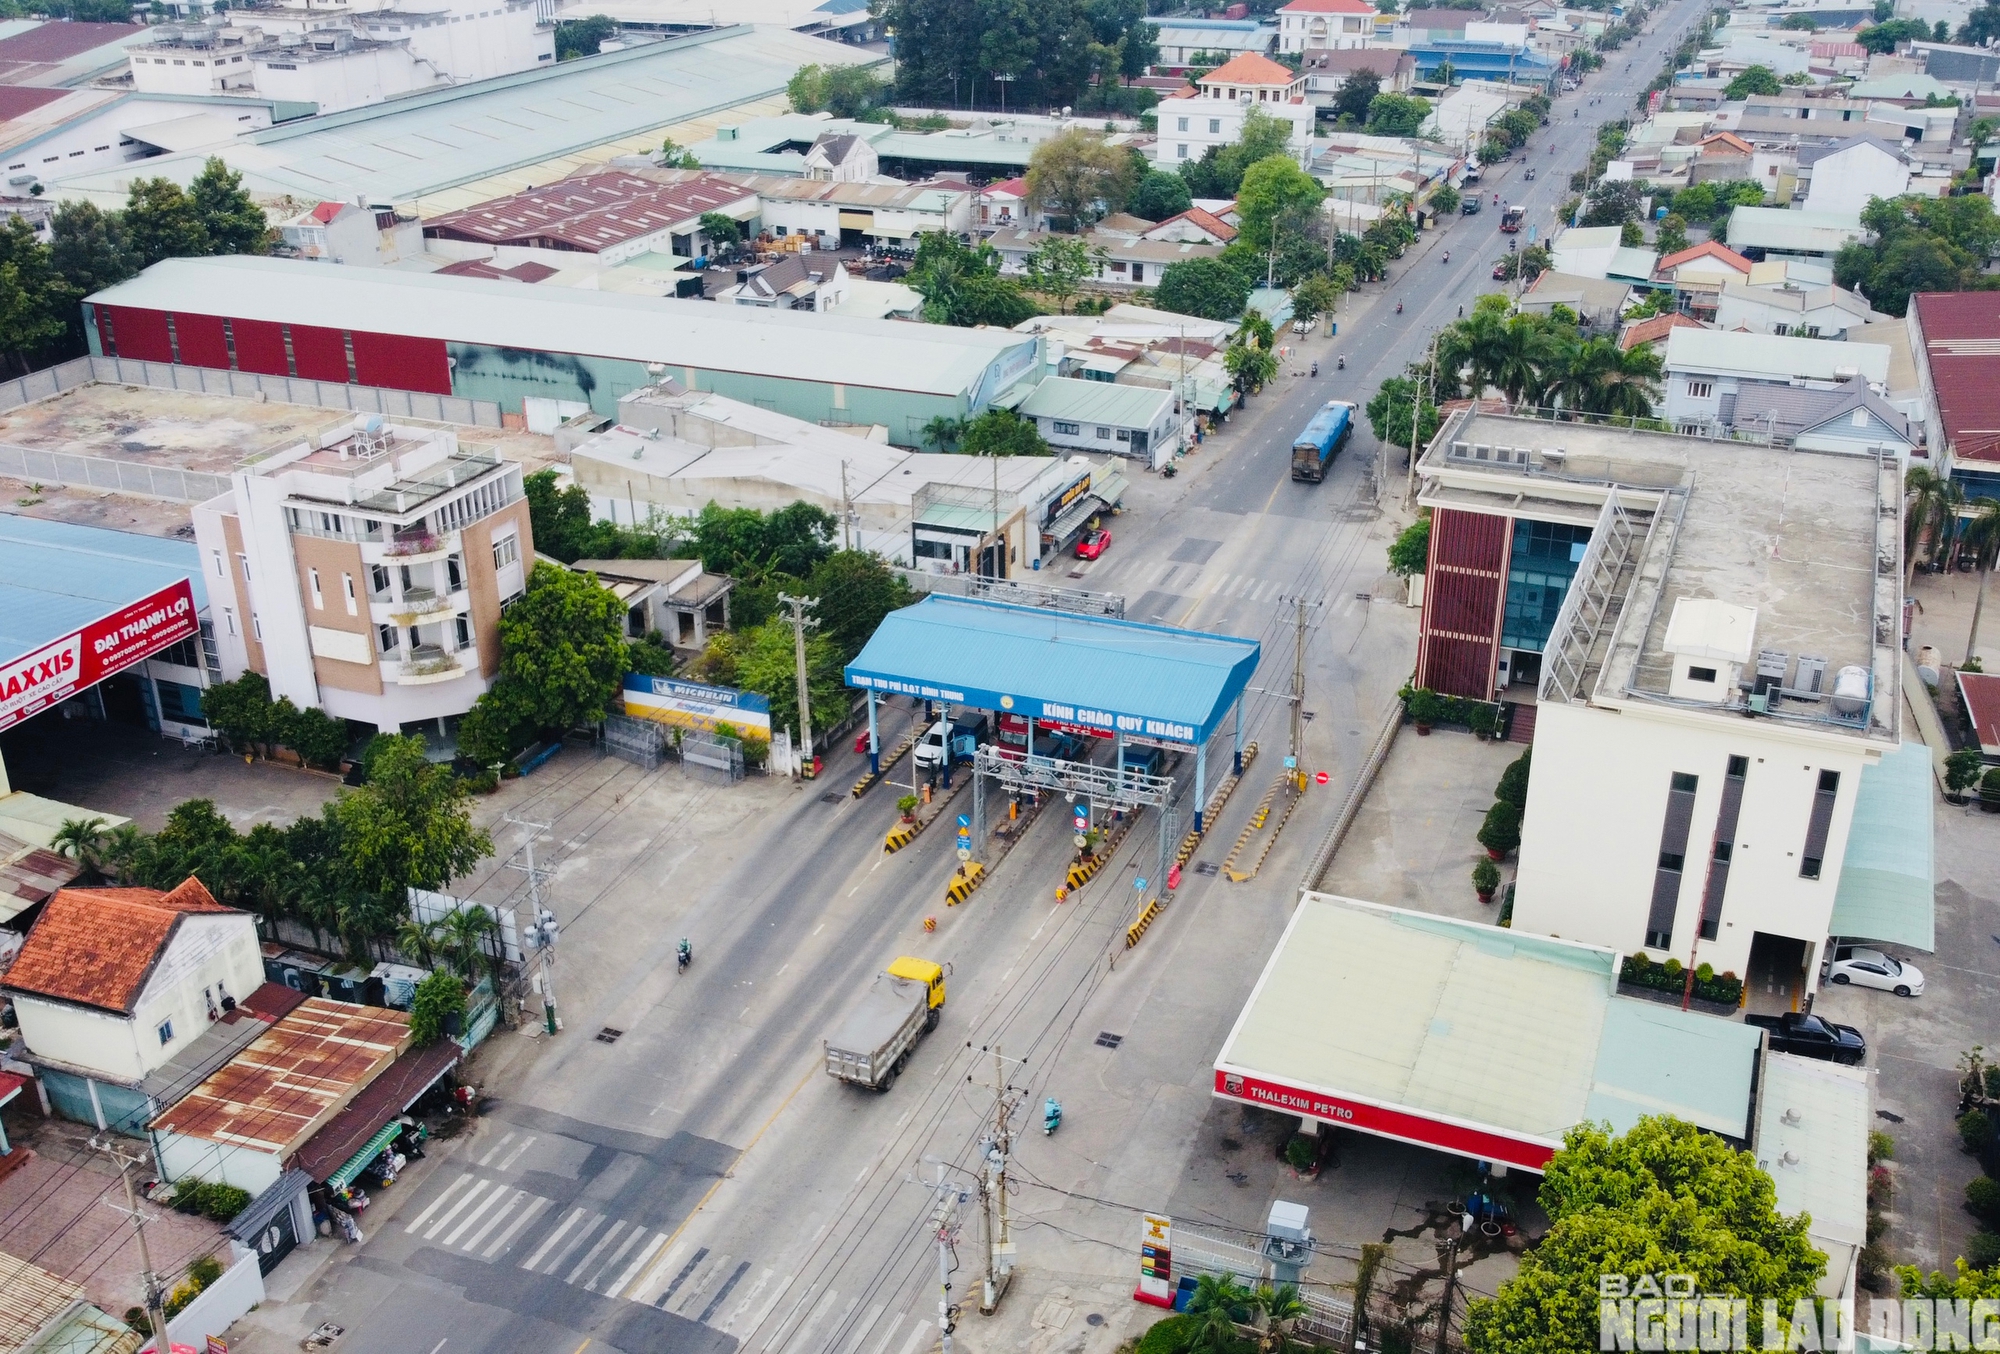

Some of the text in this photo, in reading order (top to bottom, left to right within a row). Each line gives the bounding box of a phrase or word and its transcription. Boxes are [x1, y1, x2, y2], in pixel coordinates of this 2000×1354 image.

[94, 632, 120, 654] ĐẠI
[120, 609, 166, 640] THẠNH
[167, 597, 190, 618] LỢI
[38, 684, 50, 694] CAO
[52, 677, 64, 686] CẤP
[674, 686, 733, 702] MICHELIN
[873, 678, 888, 688] THU
[889, 681, 901, 691] PHÍ
[902, 684, 920, 694] B.O.T
[1043, 702, 1193, 740] KÍNH CHÀO QUÝ KHÁCH
[1060, 726, 1092, 735] ETC
[1251, 1087, 1310, 1110] THALEXIM
[1314, 1102, 1353, 1119] PETRO
